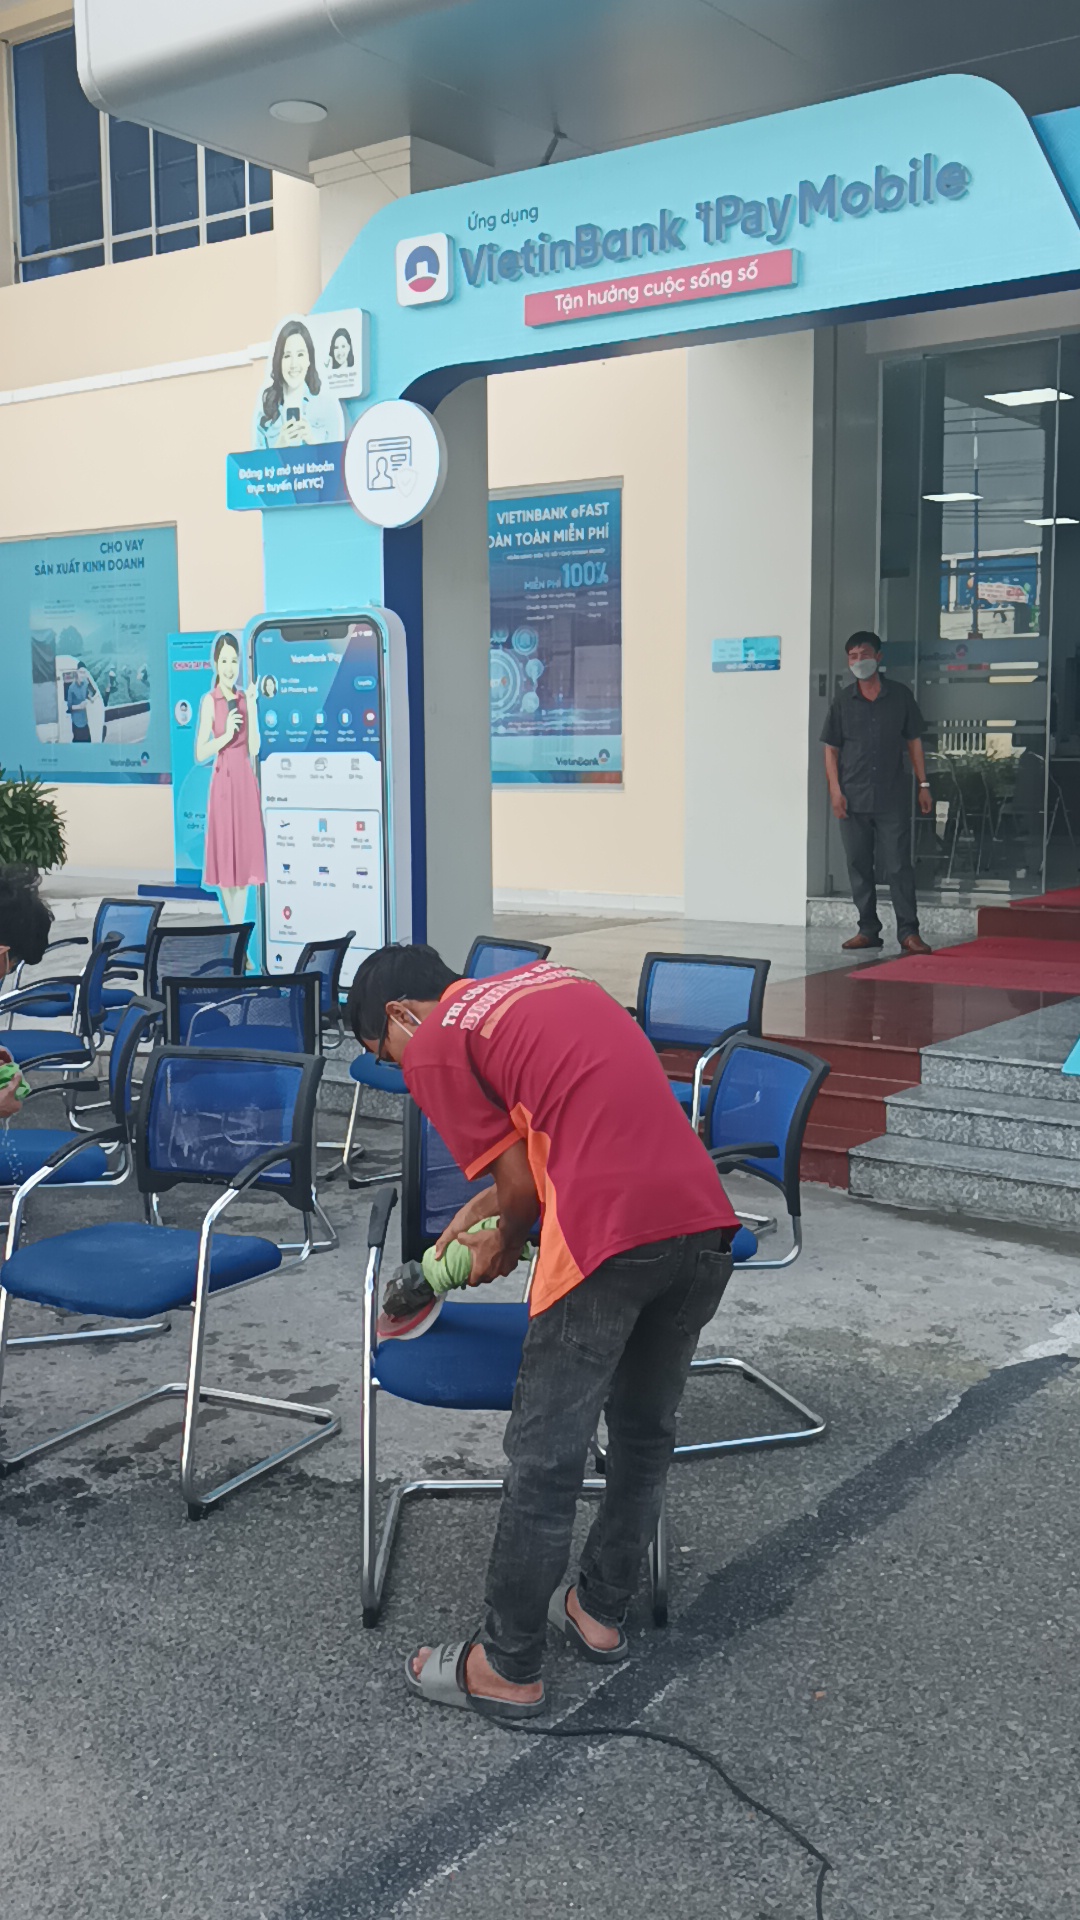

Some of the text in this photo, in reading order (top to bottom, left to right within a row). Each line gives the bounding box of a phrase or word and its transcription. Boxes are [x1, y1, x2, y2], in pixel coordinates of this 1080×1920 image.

[458, 208, 688, 288] VietinBank
[799, 153, 971, 227] Mobile
[467, 206, 539, 232] Ứng dụng
[554, 259, 759, 315] Tận hưởng cuộc sống số
[496, 502, 609, 525] VIETINBANK eFAST
[100, 539, 145, 554] CHO VAY
[488, 522, 609, 549] OÀN TOÀN MIỄN PHÍ
[34, 557, 145, 576] SẢN XUẤT KINH DOANH
[562, 561, 609, 589] 100%
